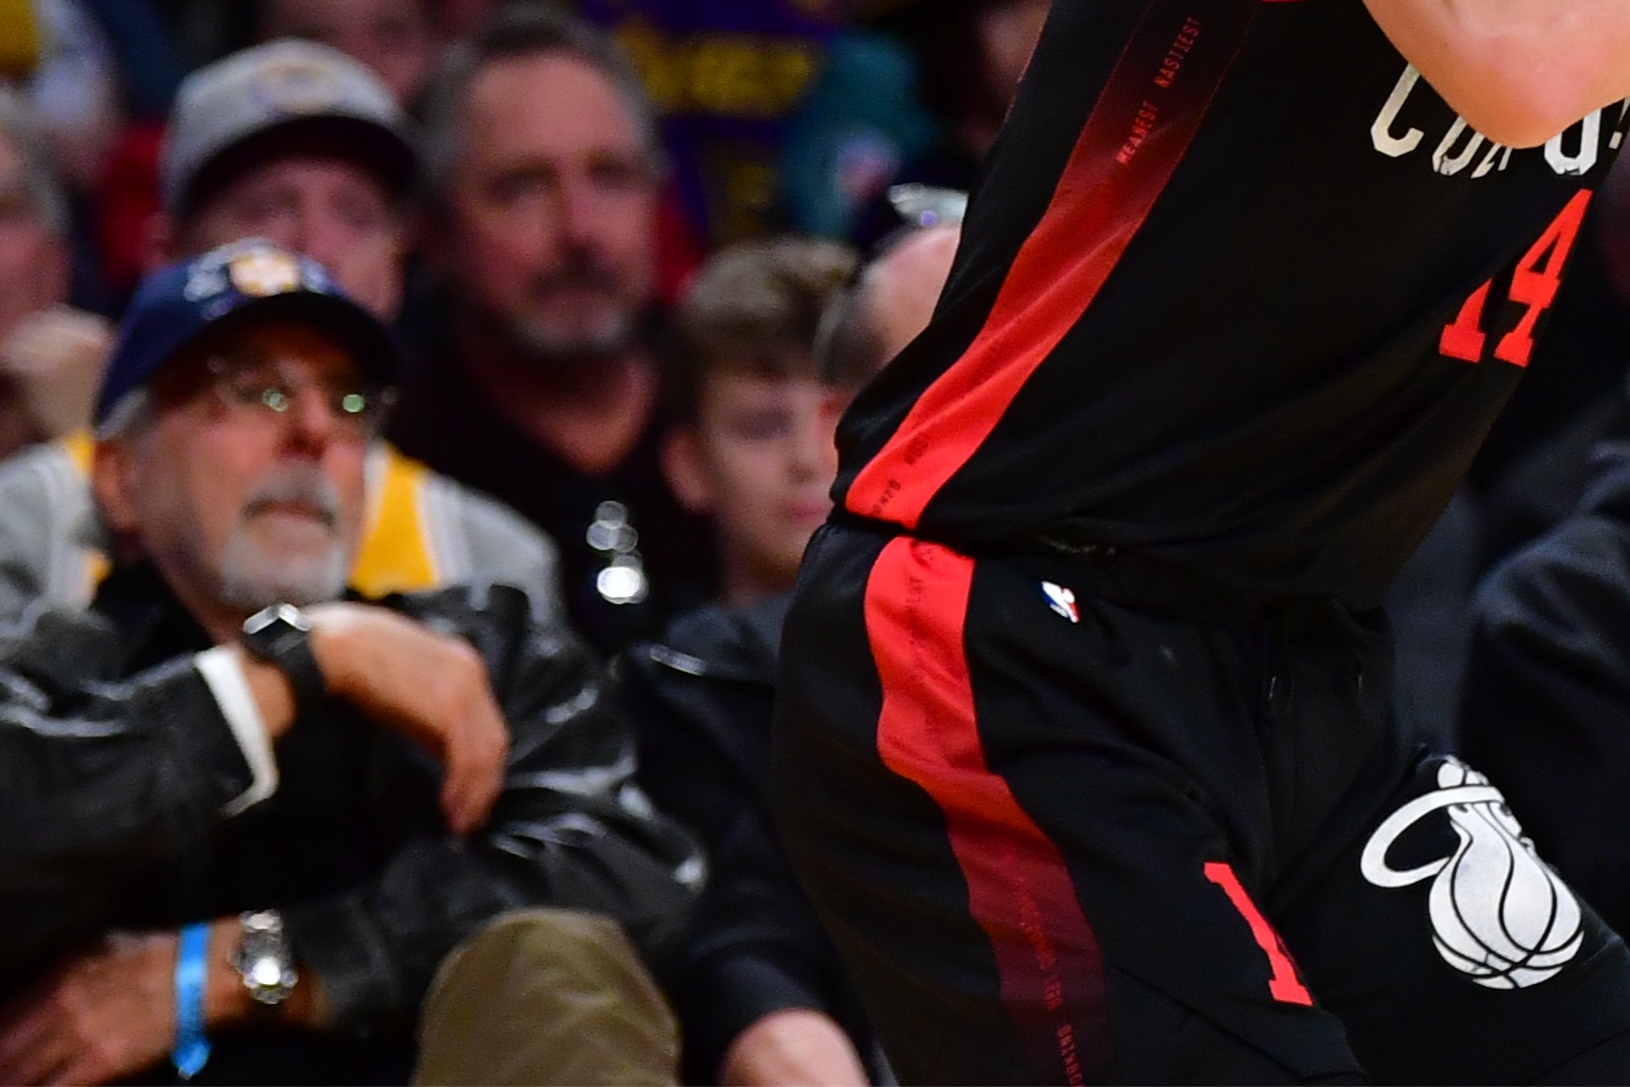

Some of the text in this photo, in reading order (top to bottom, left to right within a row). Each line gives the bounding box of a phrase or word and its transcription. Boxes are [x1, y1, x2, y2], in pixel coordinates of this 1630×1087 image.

[1115, 99, 1158, 166] MEANEST
[1153, 16, 1201, 89] NASTIEST
[1438, 187, 1593, 368] 14
[1056, 1023, 1087, 1087] ORKING
